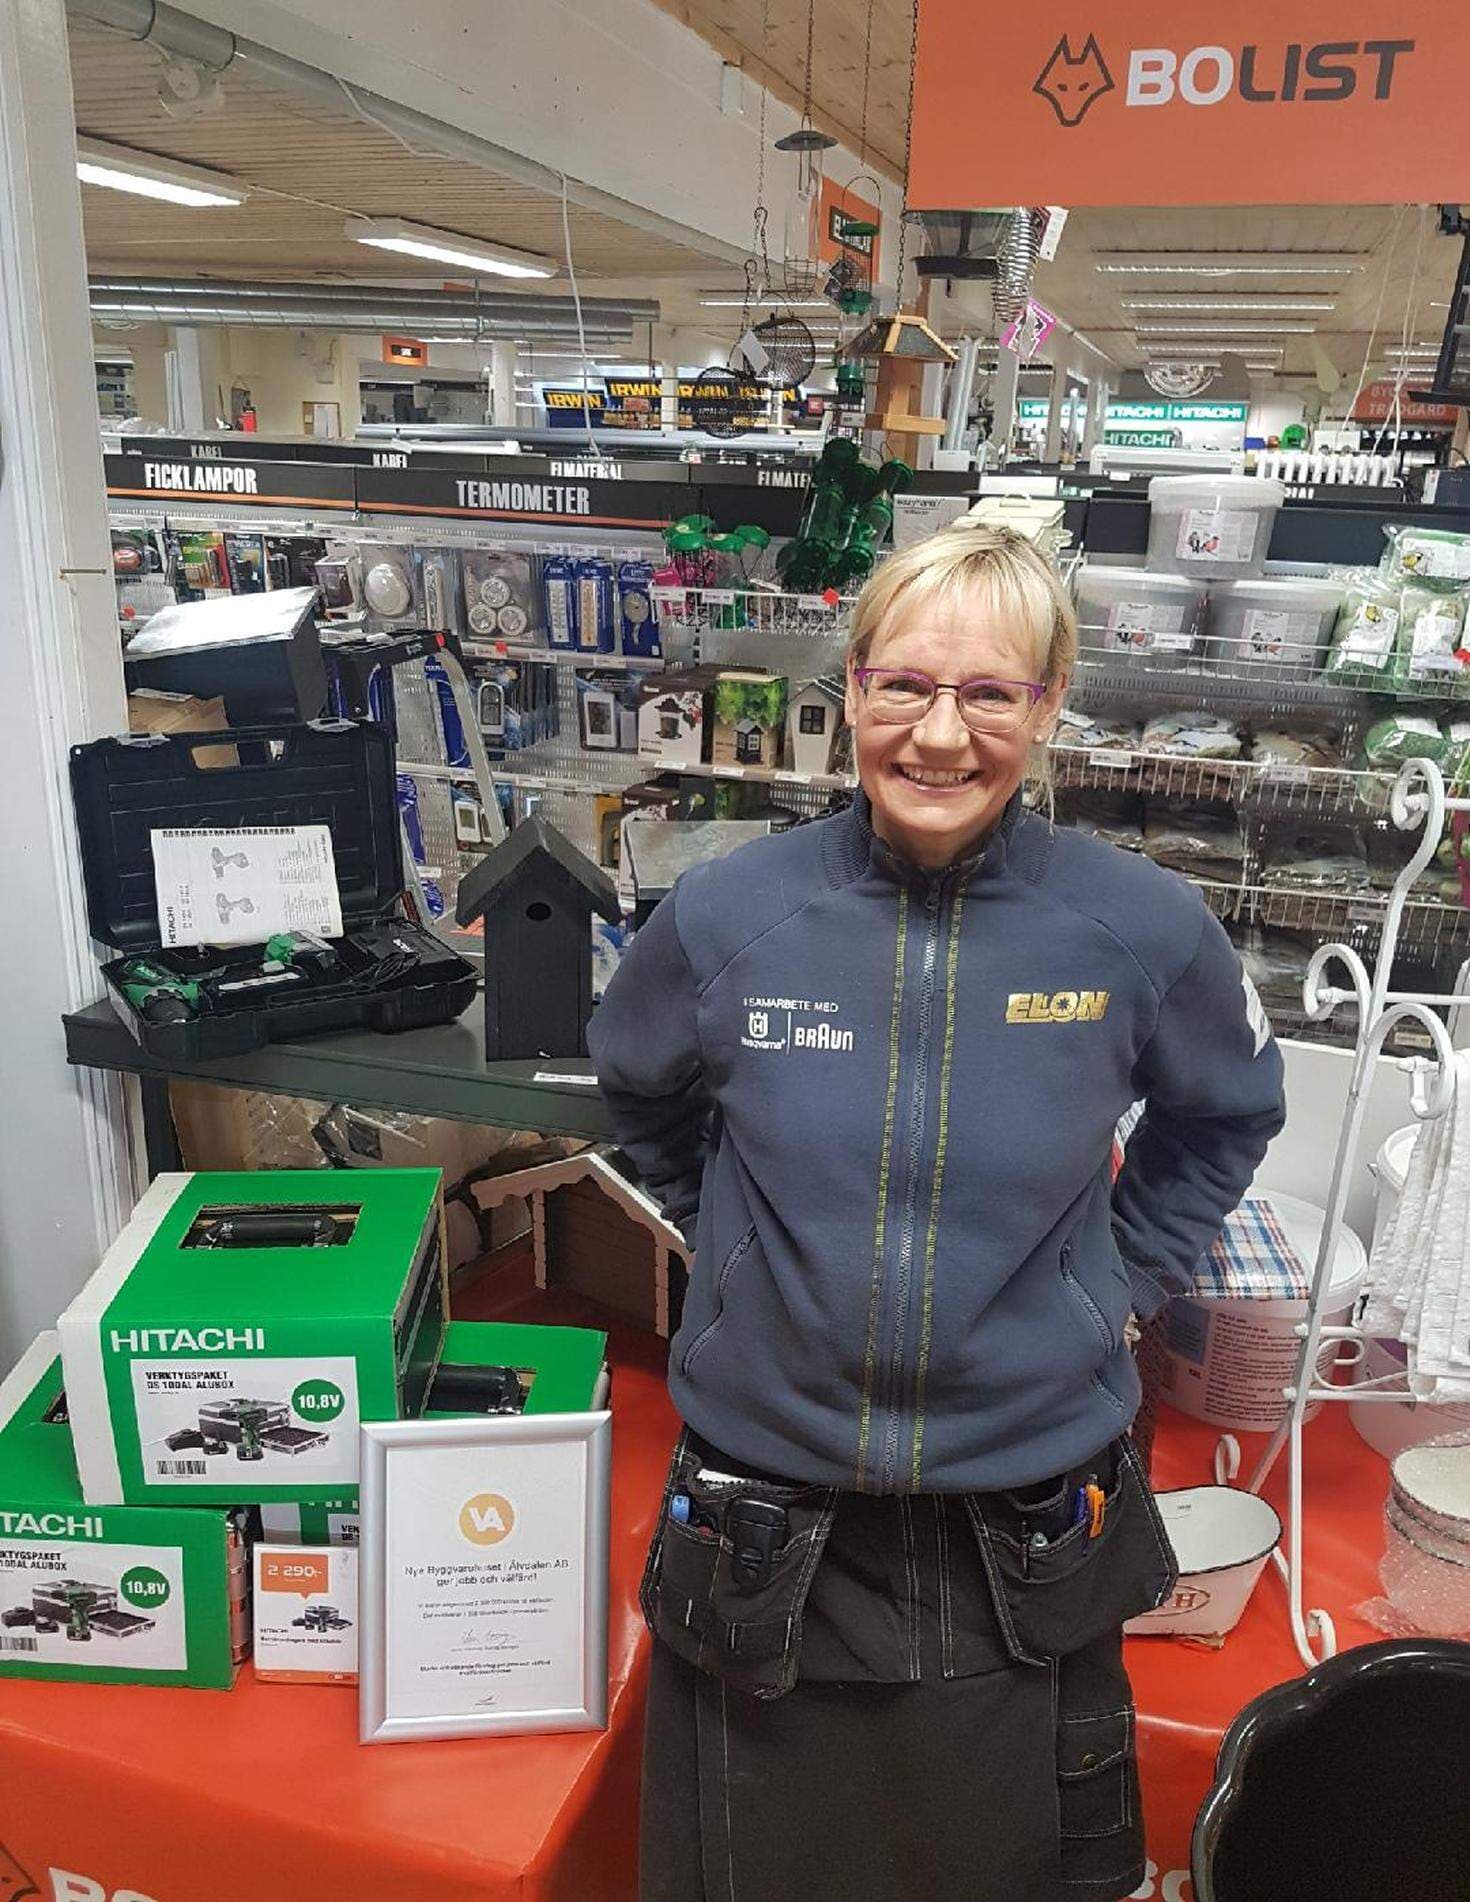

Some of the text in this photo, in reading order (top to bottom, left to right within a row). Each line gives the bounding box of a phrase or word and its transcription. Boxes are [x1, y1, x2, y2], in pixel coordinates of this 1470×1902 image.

[1126, 40, 1415, 106] BOLIST
[548, 394, 601, 408] IRWN
[1173, 406, 1243, 419] HITACHI
[144, 463, 258, 494] FICKLAMPOR
[456, 480, 590, 514] TERMOMETER
[749, 998, 811, 1010] SAMARBETE
[814, 1002, 839, 1013] MED
[1006, 991, 1110, 1023] ELON
[795, 1023, 853, 1051] BRAUN
[109, 1328, 265, 1352] HITACHI
[145, 1371, 228, 1380] VERKTYGSPAKET
[196, 1380, 235, 1389] ALUBOX
[297, 1393, 340, 1409] 10,8V
[31, 1561, 67, 1571] ALUBOX
[268, 1564, 279, 1576] 2
[480, 1574, 498, 1585] och
[126, 1580, 166, 1596] 10,8V
